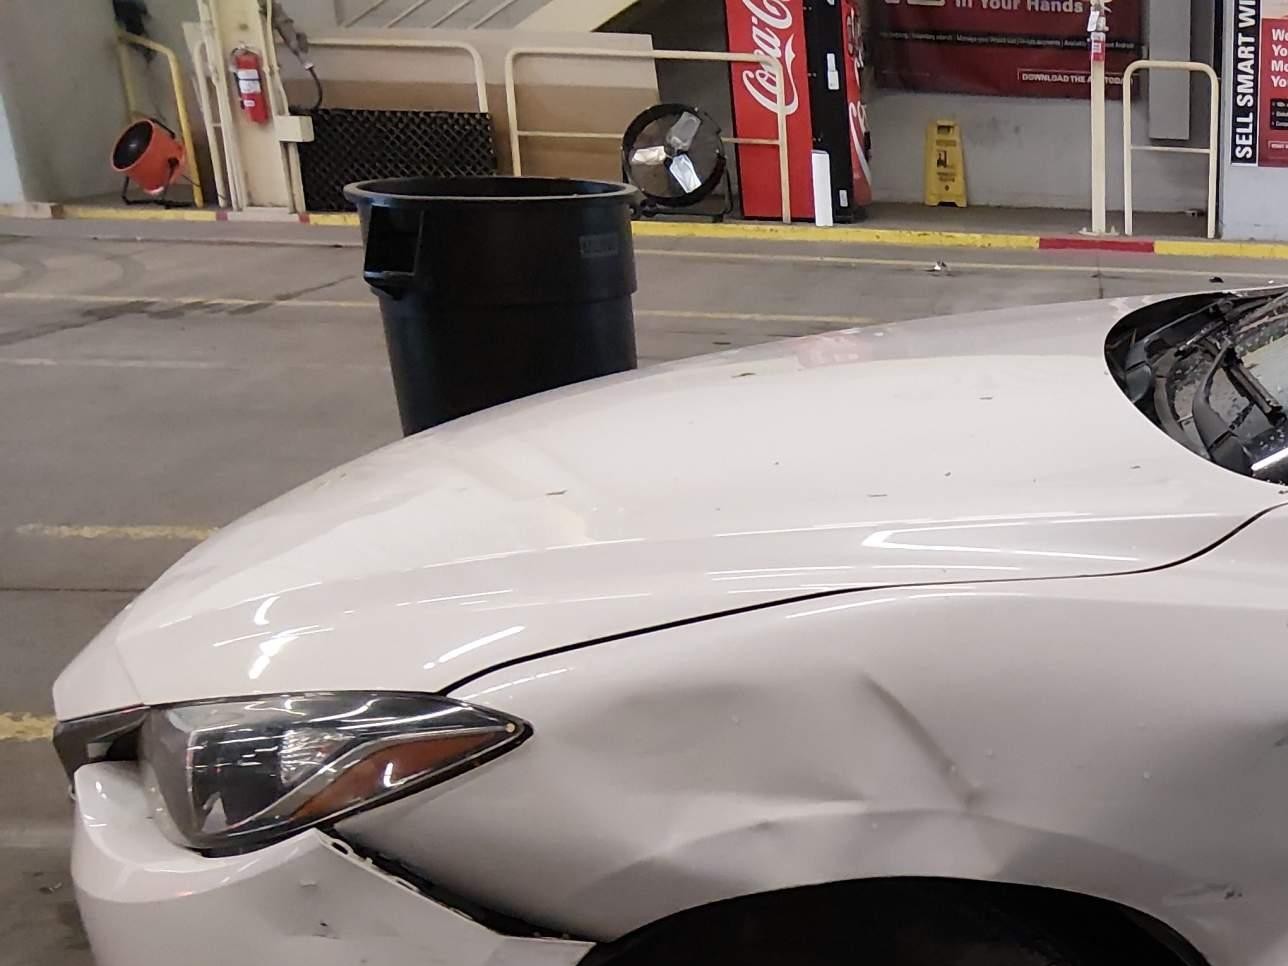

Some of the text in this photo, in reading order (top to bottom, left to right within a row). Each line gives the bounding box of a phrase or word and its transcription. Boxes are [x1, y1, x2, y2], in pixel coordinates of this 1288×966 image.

[981, 0, 1019, 11] Your
[1027, 0, 1084, 13] Hands
[1022, 73, 1069, 83] DOWNLOAD
[1071, 75, 1085, 83] THE
[1236, 33, 1255, 107] SMART
[1235, 112, 1254, 159] SELL
